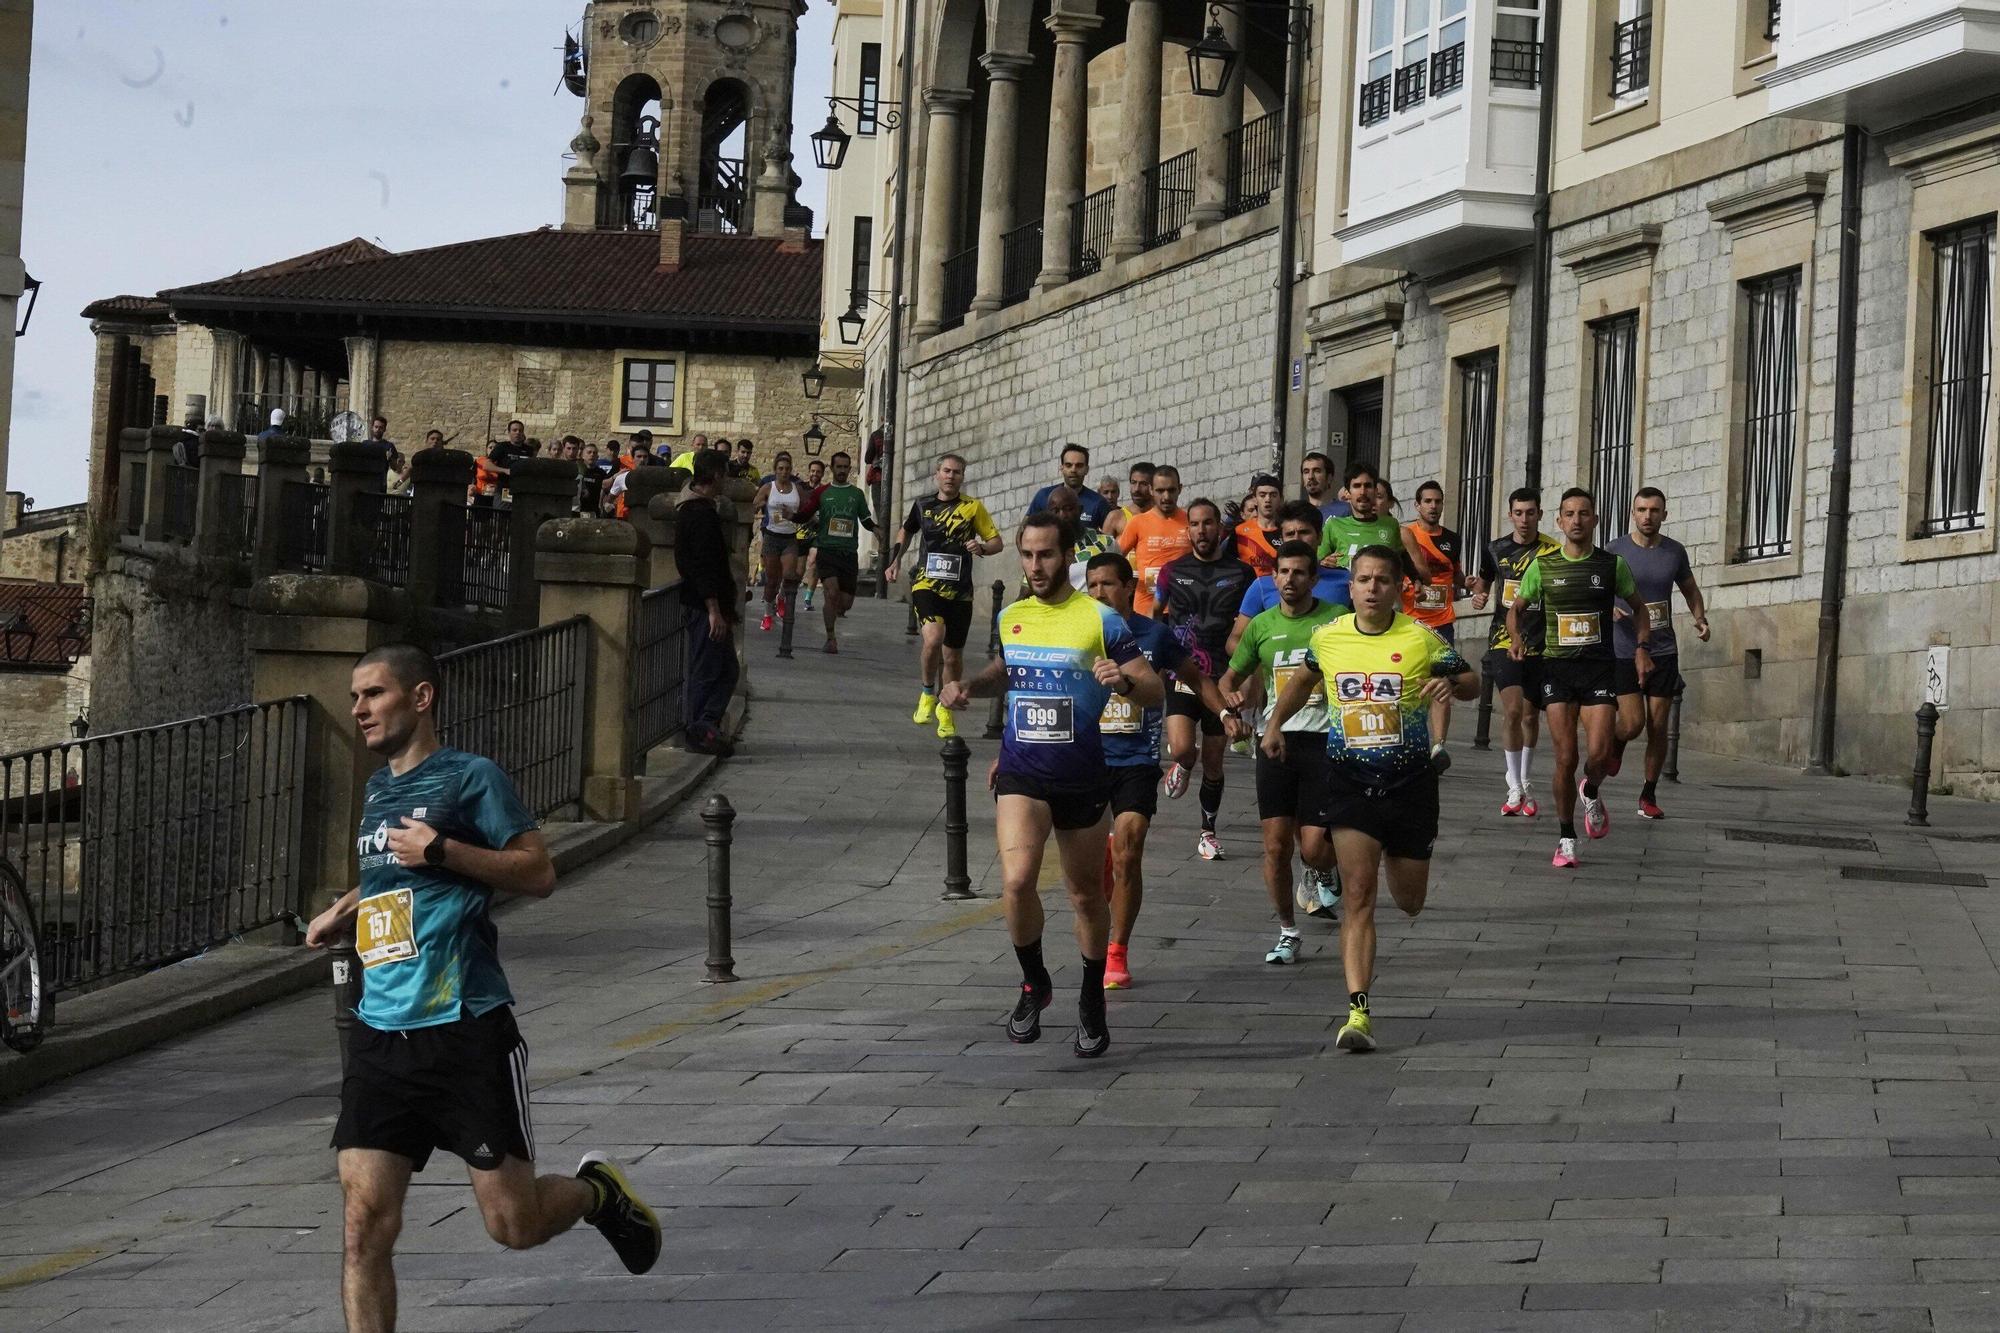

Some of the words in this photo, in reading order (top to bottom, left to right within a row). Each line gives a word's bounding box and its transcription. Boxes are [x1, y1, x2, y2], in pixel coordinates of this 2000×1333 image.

[1569, 621, 1590, 634] 446
[1006, 667, 1082, 680] VOLVO
[1027, 708, 1057, 726] 999
[1103, 703, 1131, 718] 330
[1359, 713, 1384, 731] 101
[368, 911, 391, 940] 157
